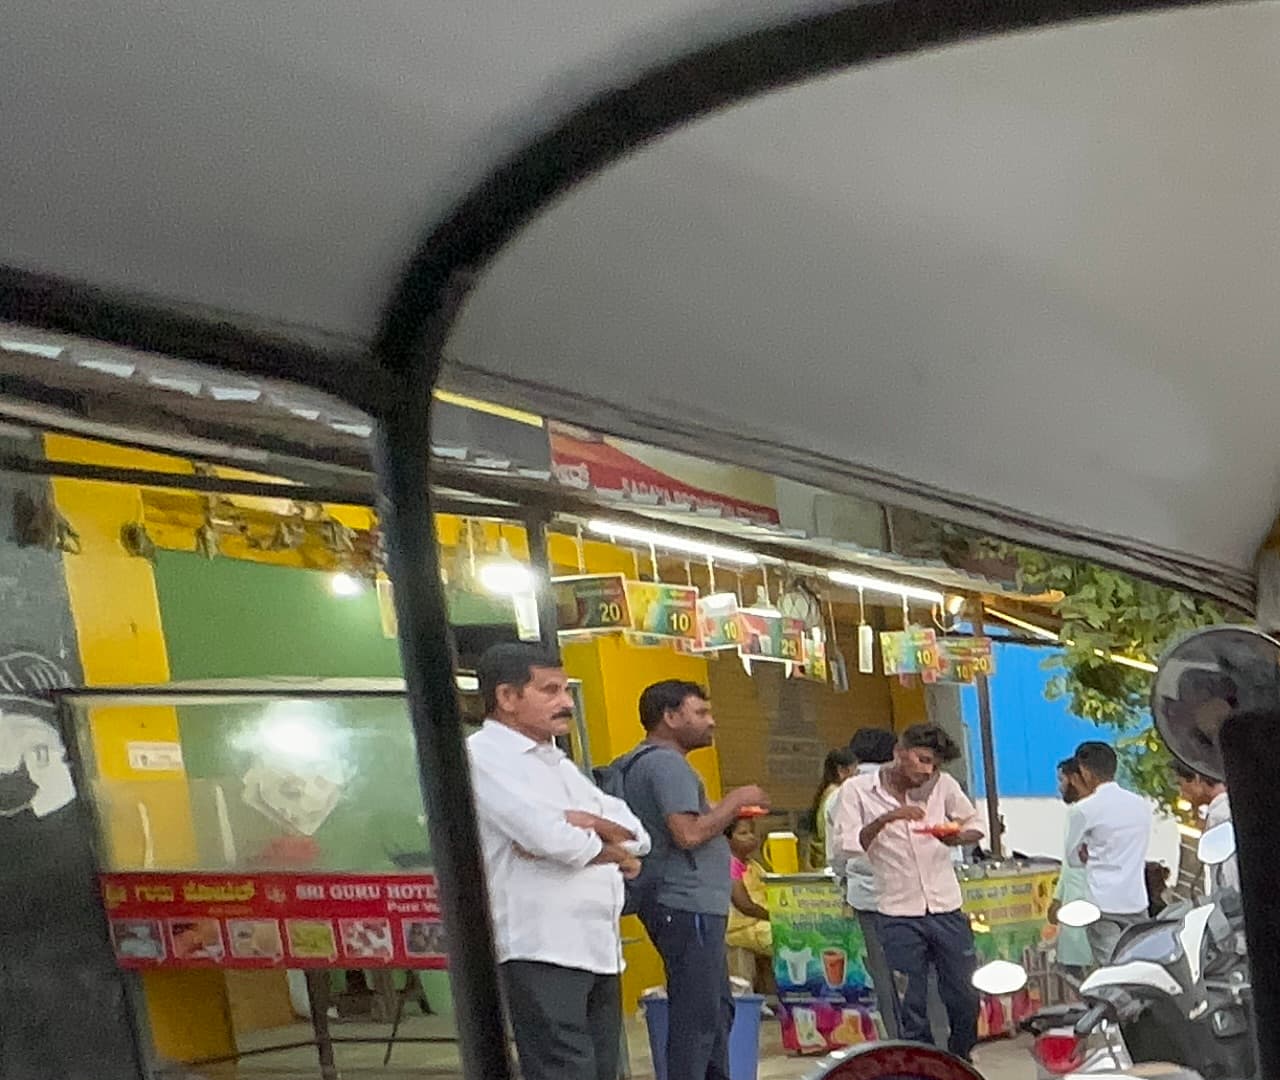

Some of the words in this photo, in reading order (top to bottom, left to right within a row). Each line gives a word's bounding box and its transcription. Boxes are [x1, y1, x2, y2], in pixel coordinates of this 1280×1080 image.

[599, 602, 622, 623] 20
[669, 612, 690, 632] 10
[723, 621, 738, 641] 10
[916, 649, 931, 665] 10
[295, 884, 324, 900] SRI
[330, 884, 380, 900] GURU
[386, 883, 440, 900] HOTE
